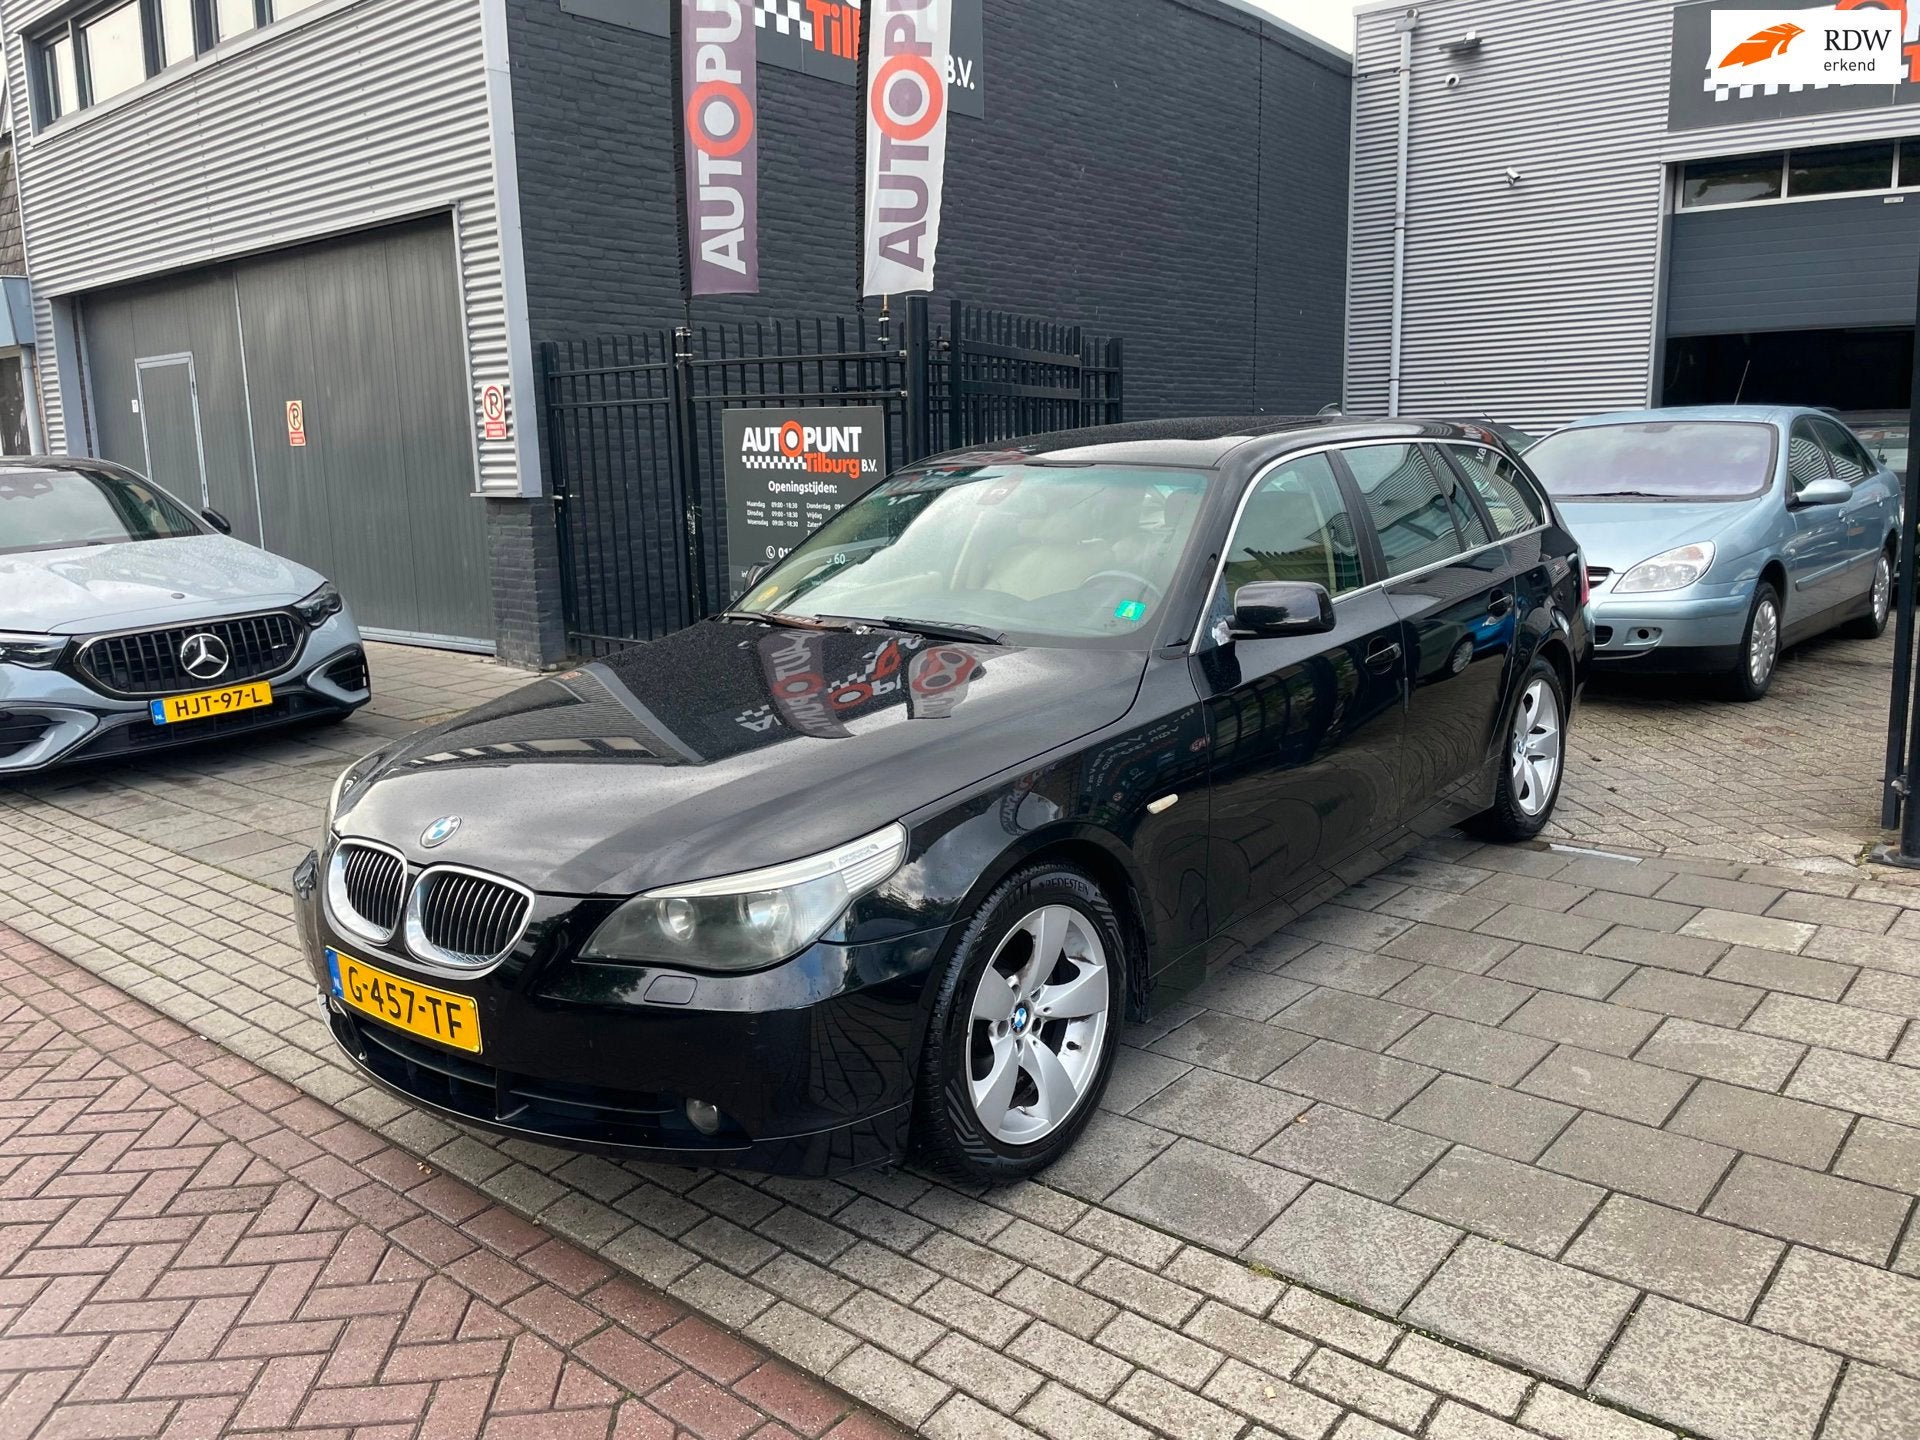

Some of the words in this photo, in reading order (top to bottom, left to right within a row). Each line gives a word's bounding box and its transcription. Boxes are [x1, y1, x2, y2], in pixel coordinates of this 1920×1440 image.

[742, 420, 862, 458] AUTOPUNT
[804, 453, 860, 479] Tilburg
[861, 459, 877, 473] B.V.
[768, 480, 838, 495] Openingstijden:
[806, 502, 831, 511] Donderdag
[806, 511, 823, 520] Vrijdag
[175, 687, 263, 717] HJT-97-L
[348, 966, 462, 1039] G-457-TF
